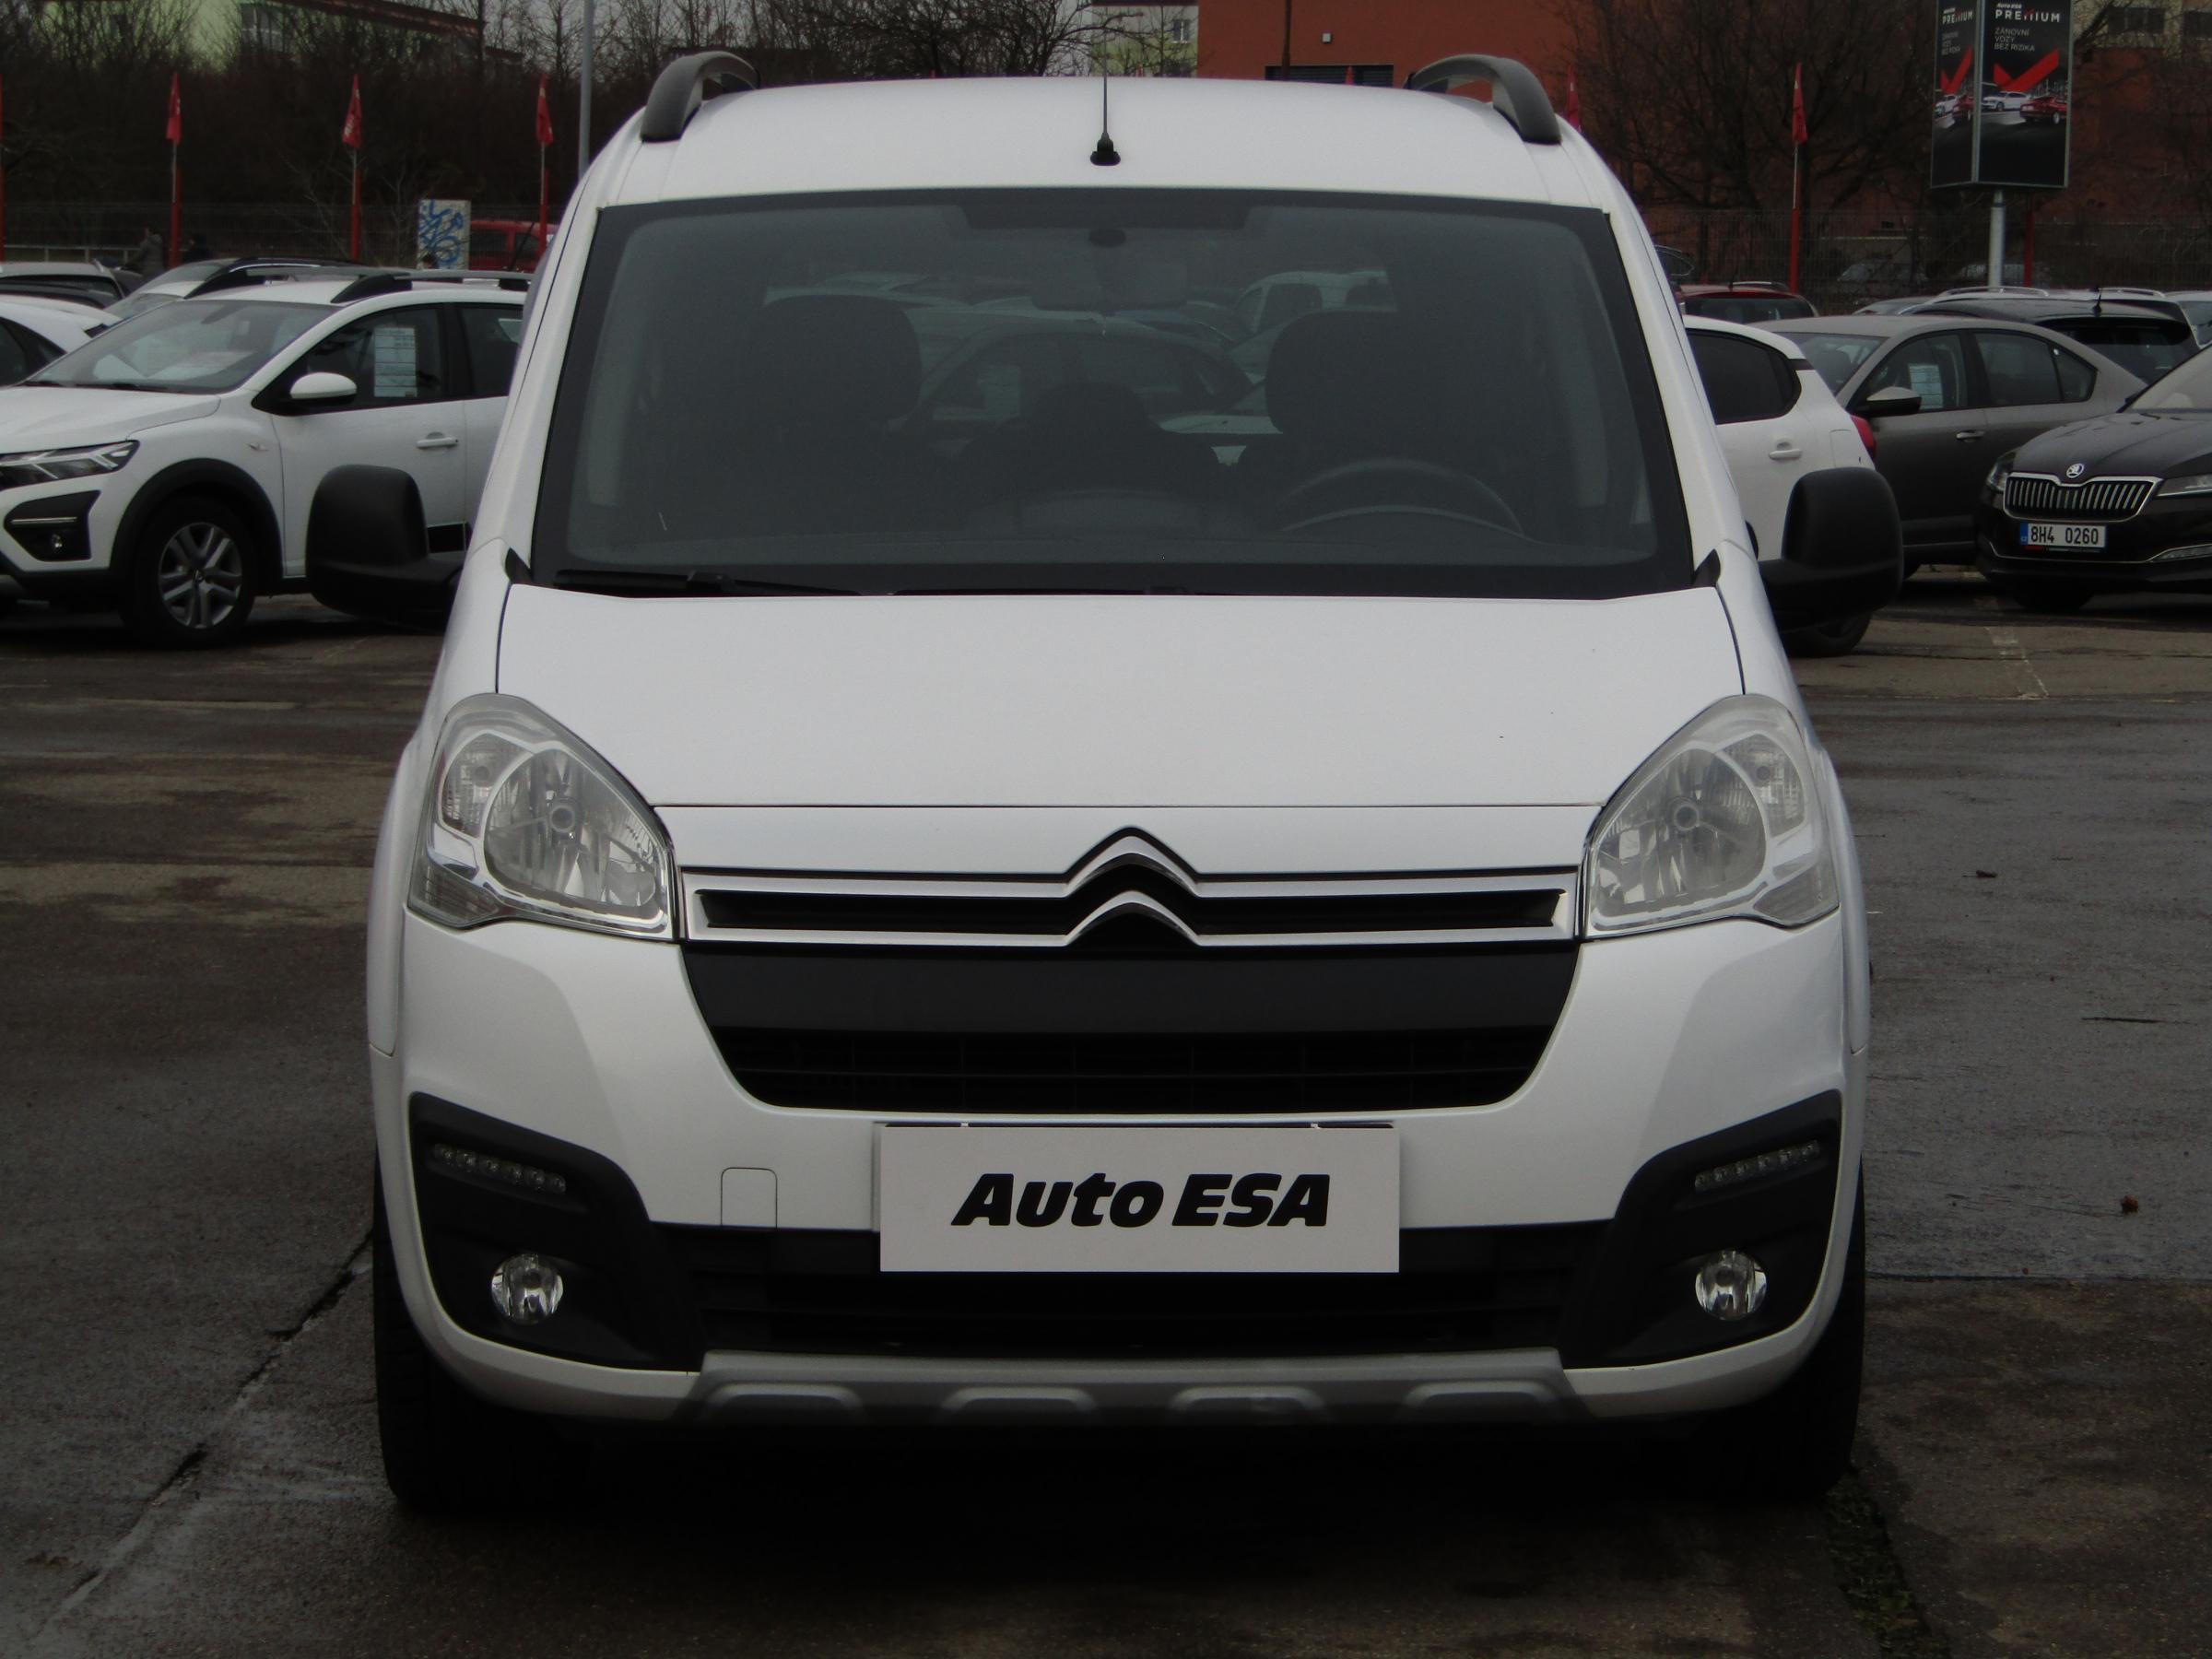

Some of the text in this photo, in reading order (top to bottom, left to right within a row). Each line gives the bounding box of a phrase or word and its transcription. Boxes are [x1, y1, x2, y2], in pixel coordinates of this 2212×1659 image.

[1994, 8, 2060, 23] PREMIUM
[2030, 526, 2054, 543] 8H4
[2065, 527, 2099, 545] 0260
[950, 1172, 1331, 1228] Auto ESA
